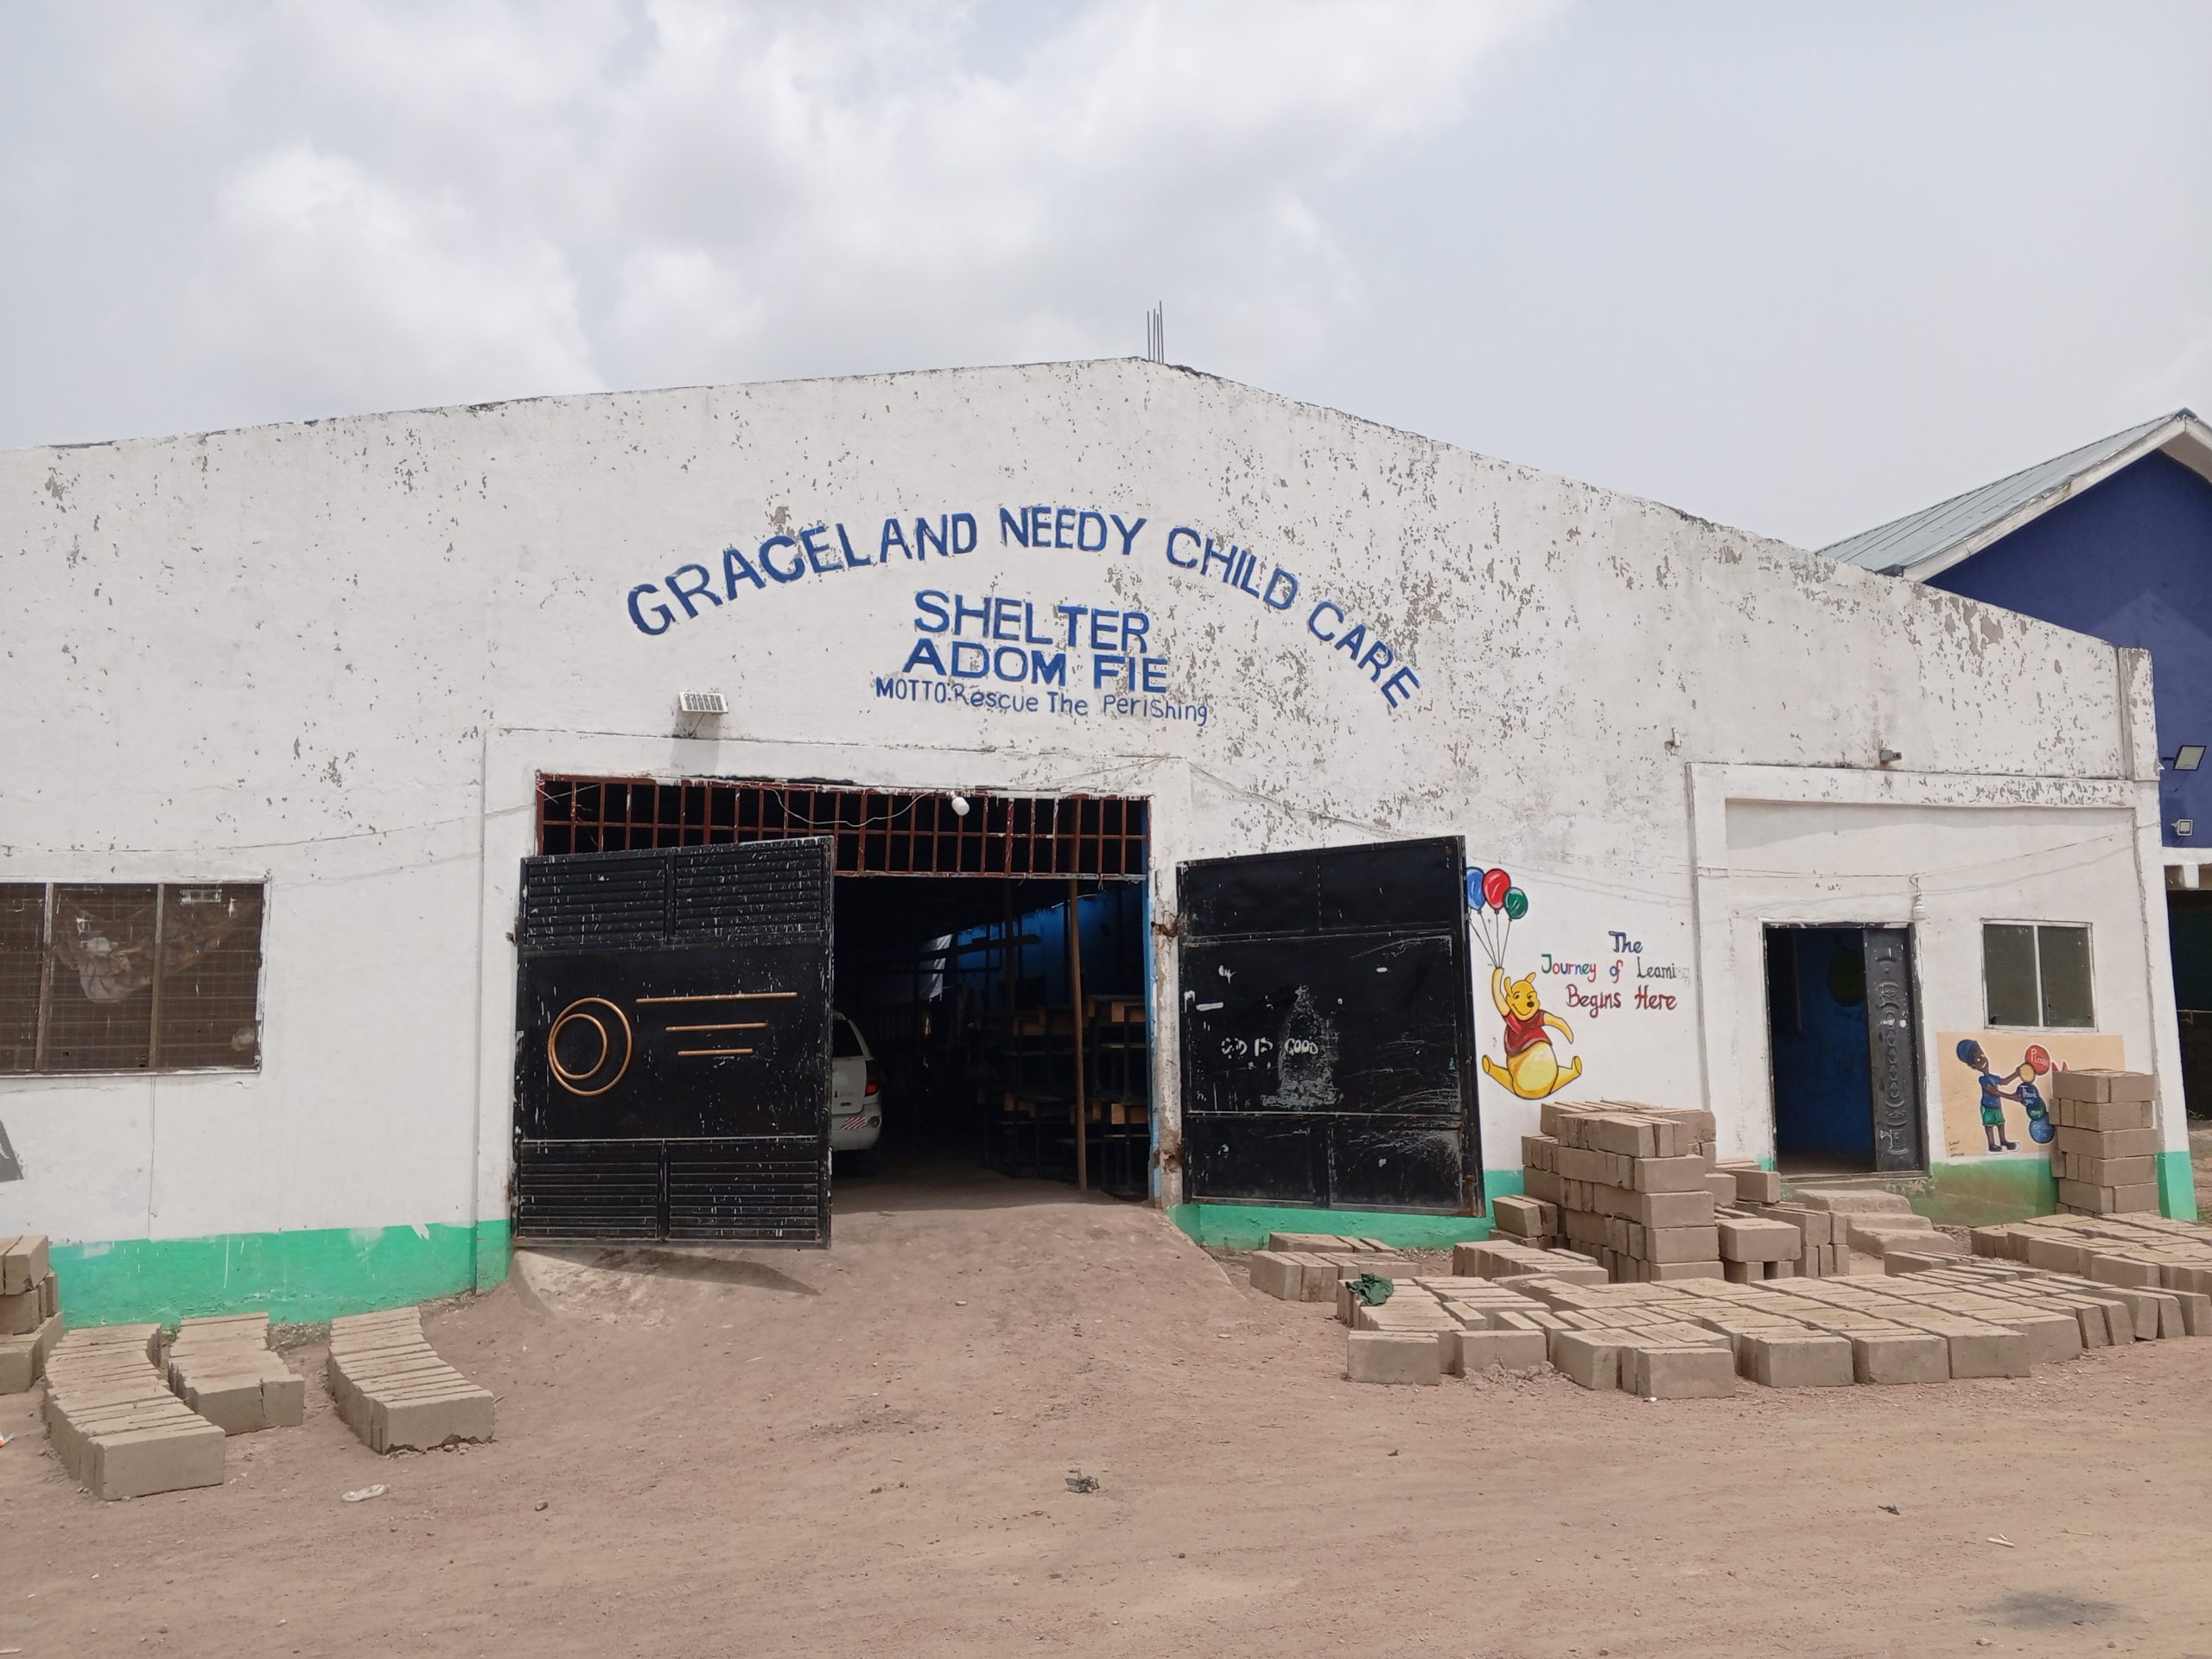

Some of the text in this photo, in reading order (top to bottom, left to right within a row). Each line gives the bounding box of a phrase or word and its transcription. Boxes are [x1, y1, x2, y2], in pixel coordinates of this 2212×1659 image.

[628, 506, 1421, 709] GRACELAND NEEDY CHILD CARE
[913, 589, 1152, 653] SHELTER
[903, 636, 1168, 693] ADOM FIE
[1046, 691, 1089, 716] The
[1608, 931, 1643, 954] The
[1541, 953, 1597, 982] Journey
[1609, 959, 1624, 983] of
[1565, 983, 1678, 1019] Begins Here
